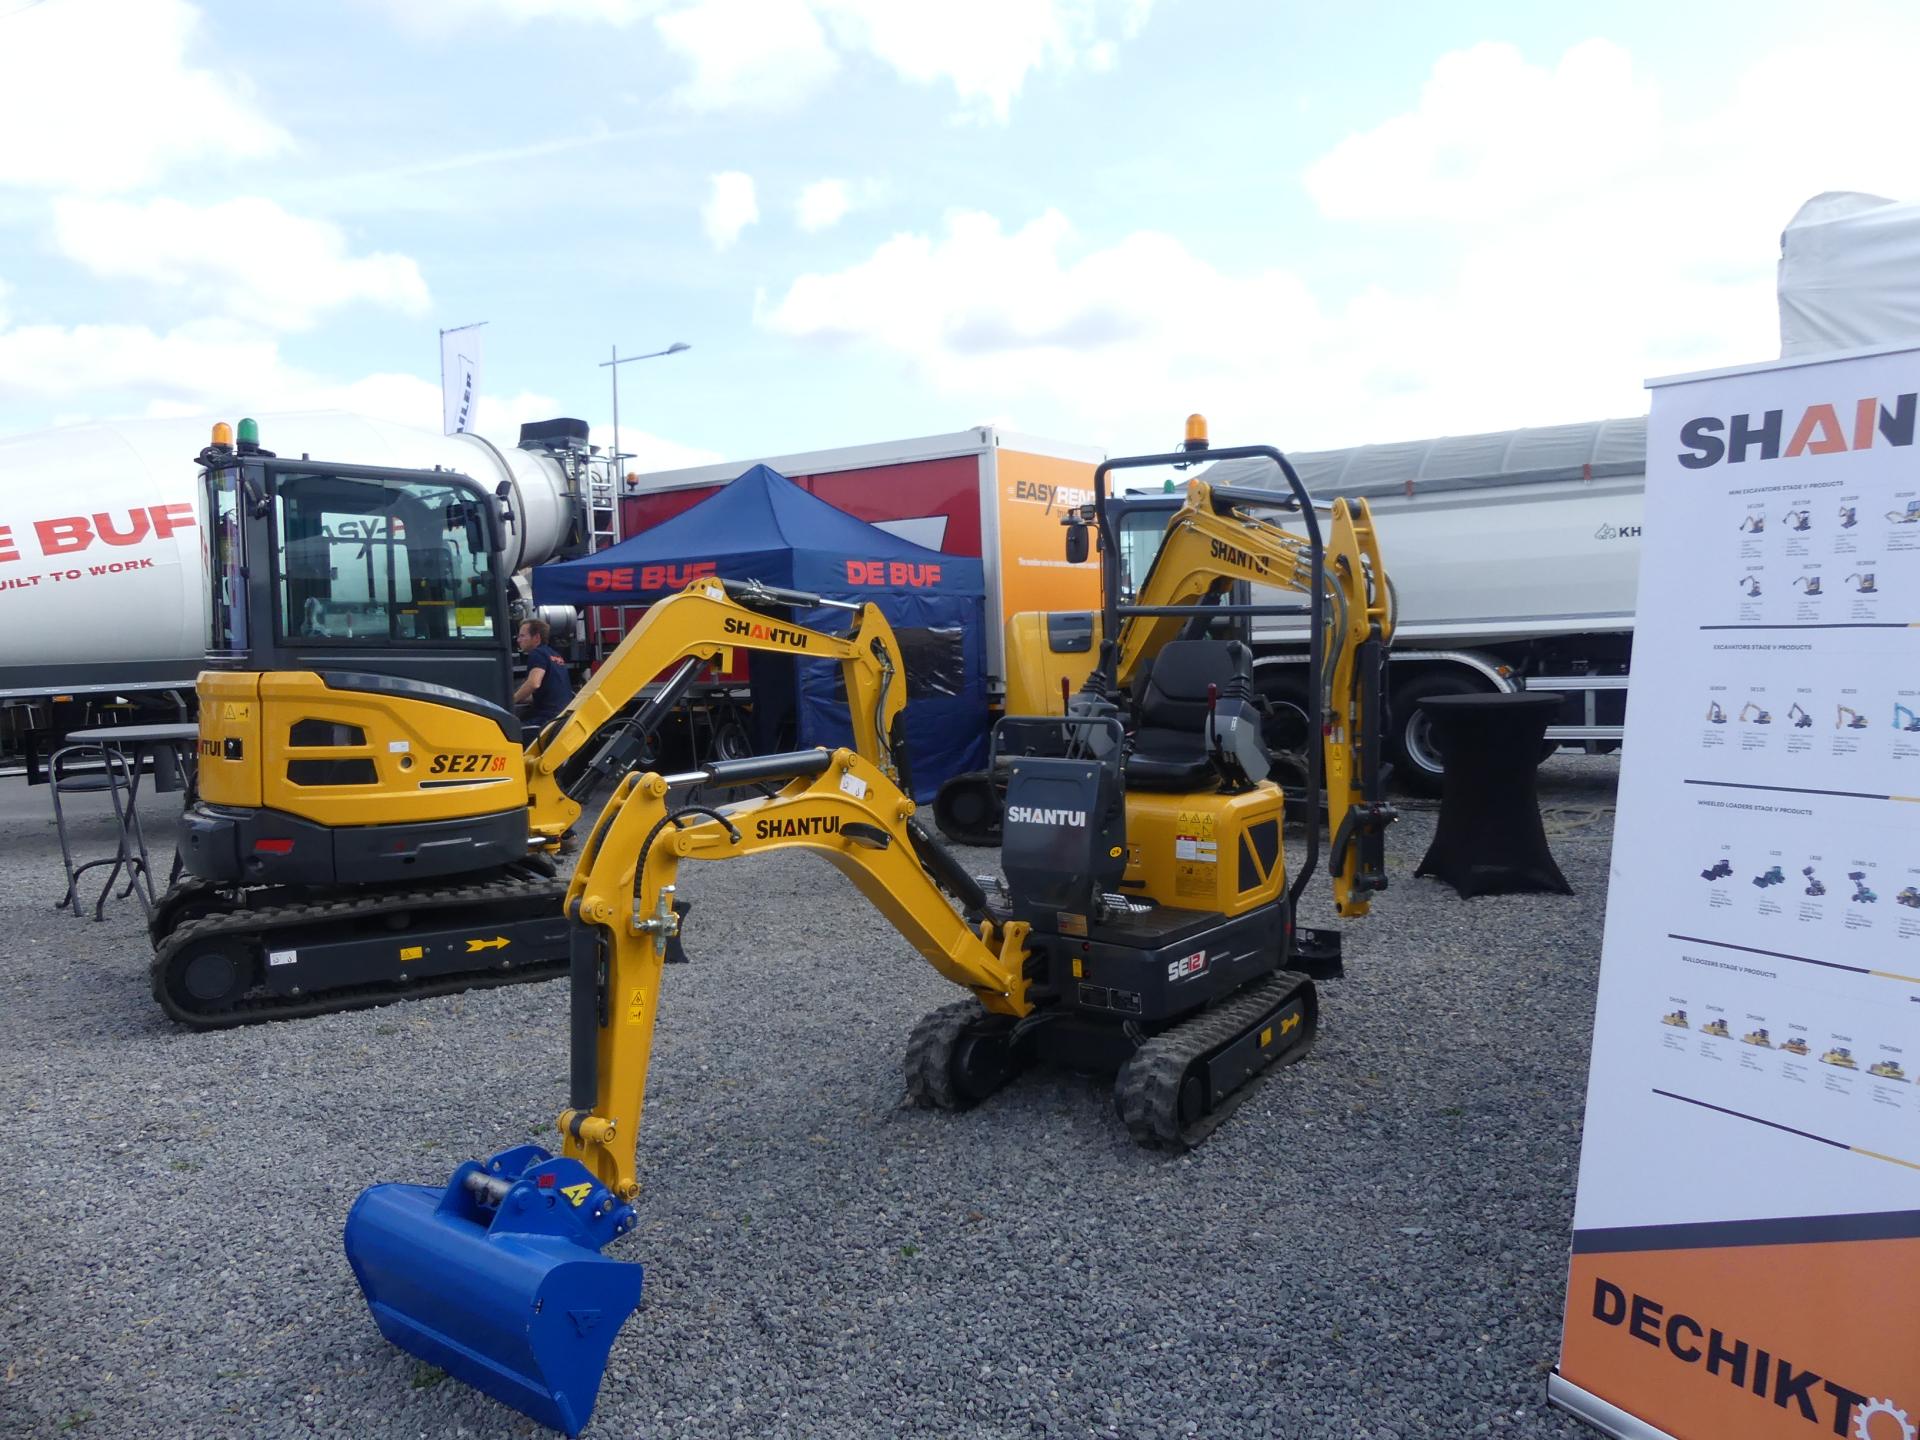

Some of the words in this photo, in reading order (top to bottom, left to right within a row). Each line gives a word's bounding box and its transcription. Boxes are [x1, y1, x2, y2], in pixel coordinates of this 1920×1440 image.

[1743, 486, 1781, 495] EXCAVATORS
[33, 503, 197, 557] BUF
[50, 569, 82, 582] TO
[88, 557, 155, 576] WORK
[588, 567, 634, 592] DE
[846, 560, 885, 585] DE
[890, 562, 941, 587] BUF
[723, 617, 808, 649] SHANTUI
[1008, 806, 1086, 828] SHANTUI
[1725, 802, 1753, 810] LOADERS
[1779, 807, 1812, 815] PRODUCTS
[756, 816, 840, 840] SHANTUI
[1682, 956, 1718, 967] BULLDOZERS
[1719, 962, 1738, 971] STAGE
[1744, 967, 1776, 978] PRODUCTS
